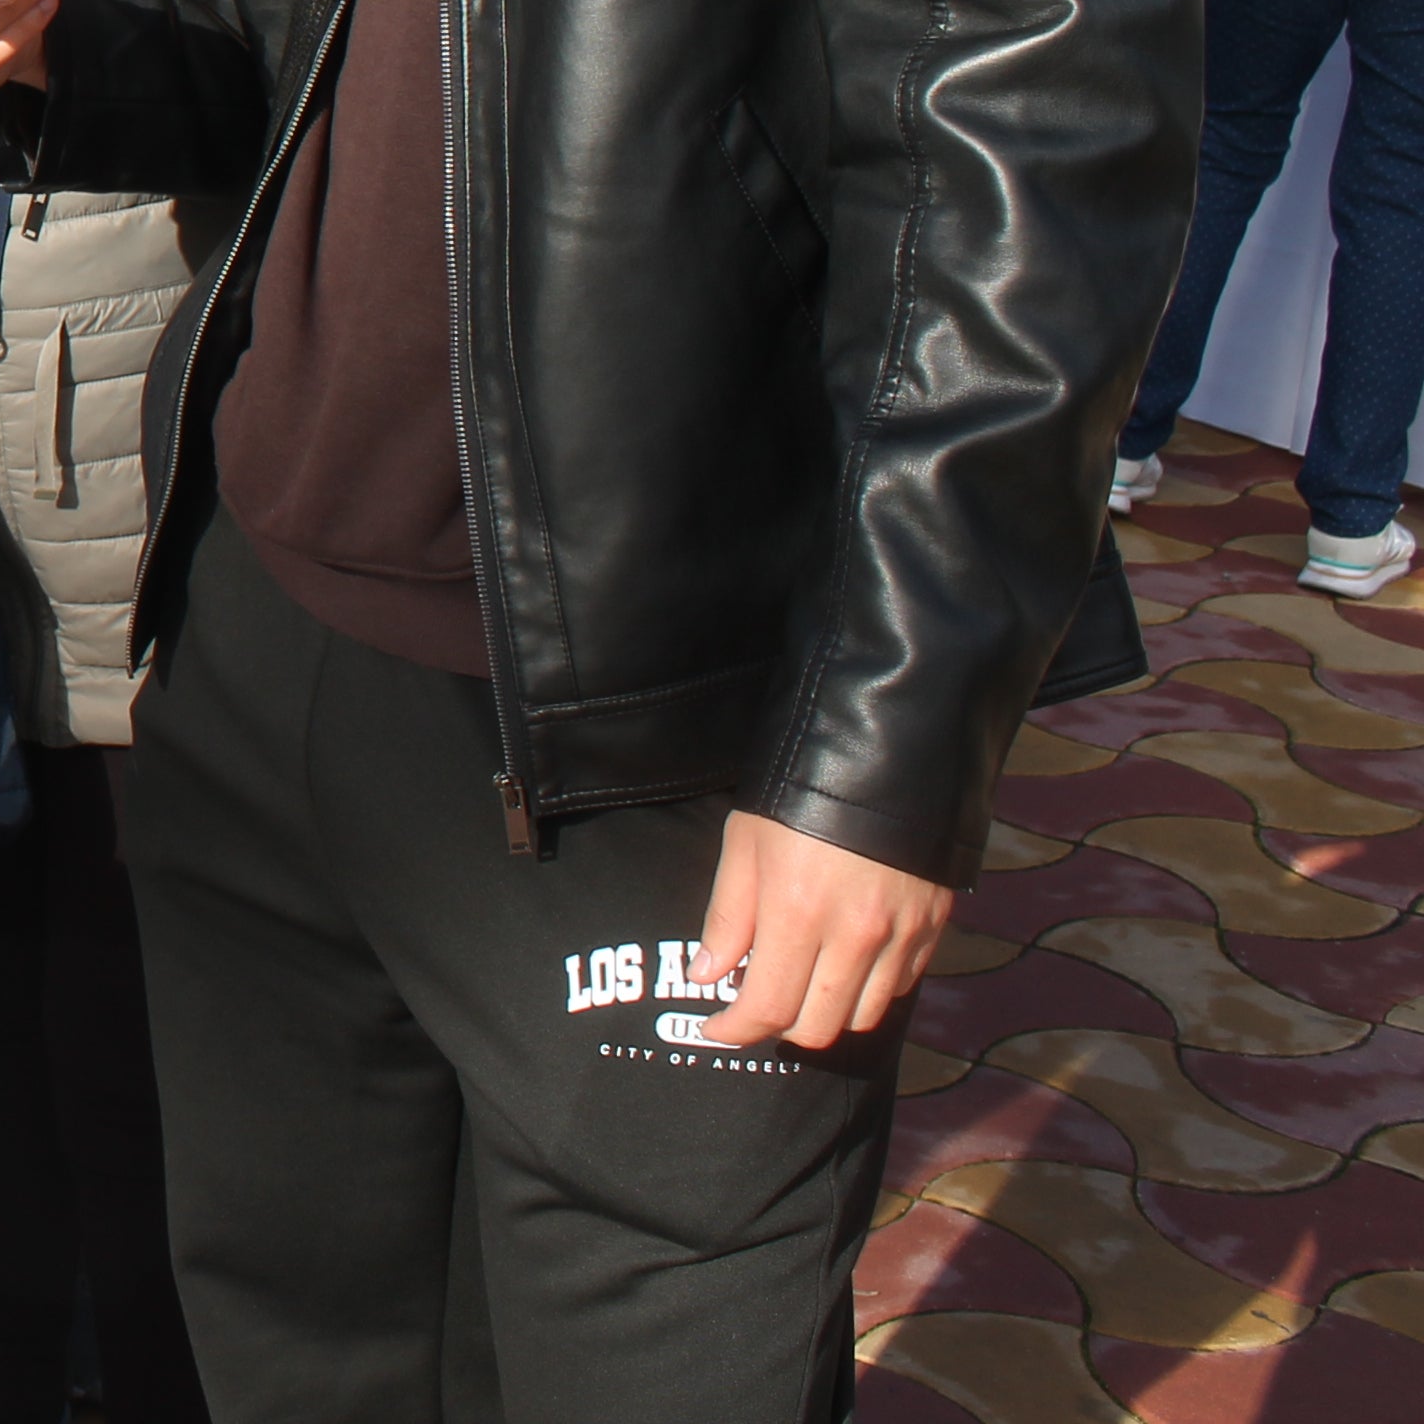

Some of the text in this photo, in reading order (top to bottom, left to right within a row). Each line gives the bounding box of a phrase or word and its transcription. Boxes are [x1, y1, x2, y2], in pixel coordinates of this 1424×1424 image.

[564, 942, 644, 1013] LOS
[599, 1043, 801, 1074] CITY OF ANGELS
